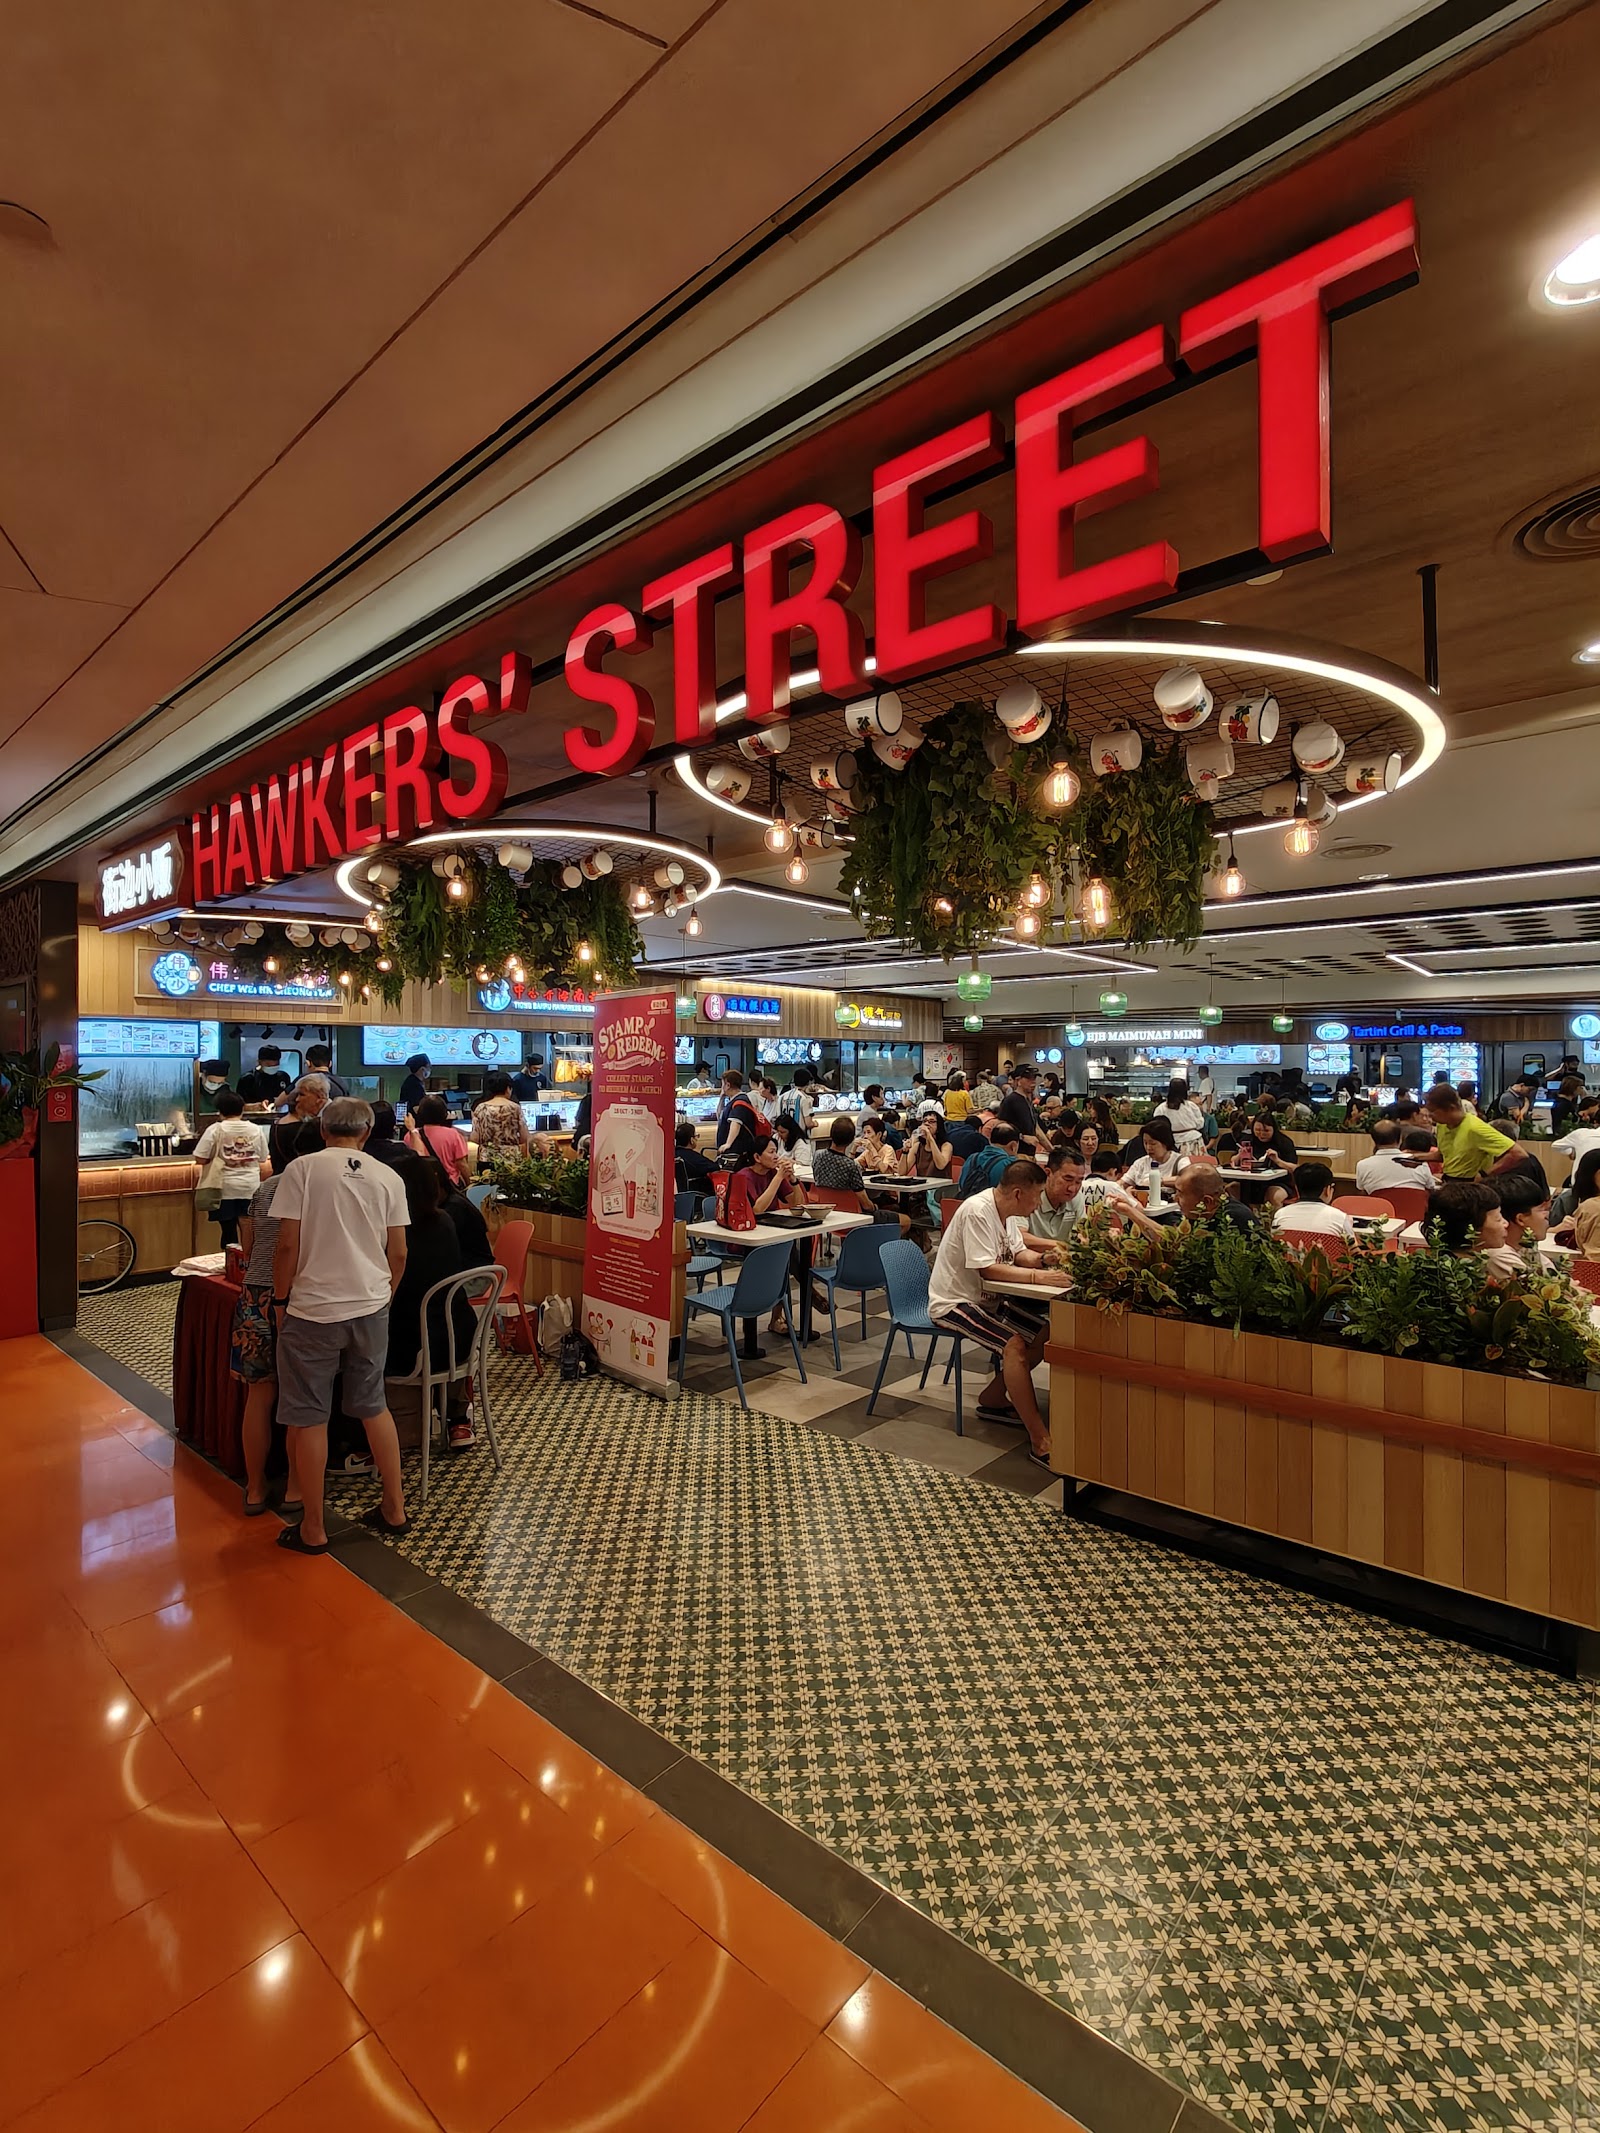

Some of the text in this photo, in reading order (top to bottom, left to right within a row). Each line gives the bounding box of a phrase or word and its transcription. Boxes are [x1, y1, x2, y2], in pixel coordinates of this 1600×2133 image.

[192, 199, 1420, 905] HAWKERS' STREET
[208, 983, 237, 993] CHEF
[599, 1016, 644, 1054] STAMP
[1086, 1028, 1203, 1044] HJH MAIMUNAH MINI
[1352, 1025, 1387, 1038] Tartini
[1389, 1024, 1415, 1037] Grill
[1417, 1025, 1428, 1037] &
[1430, 1024, 1463, 1037] Pasta
[615, 1035, 662, 1062] REDEEM
[606, 1074, 655, 1083] COLLECT STAMPS
